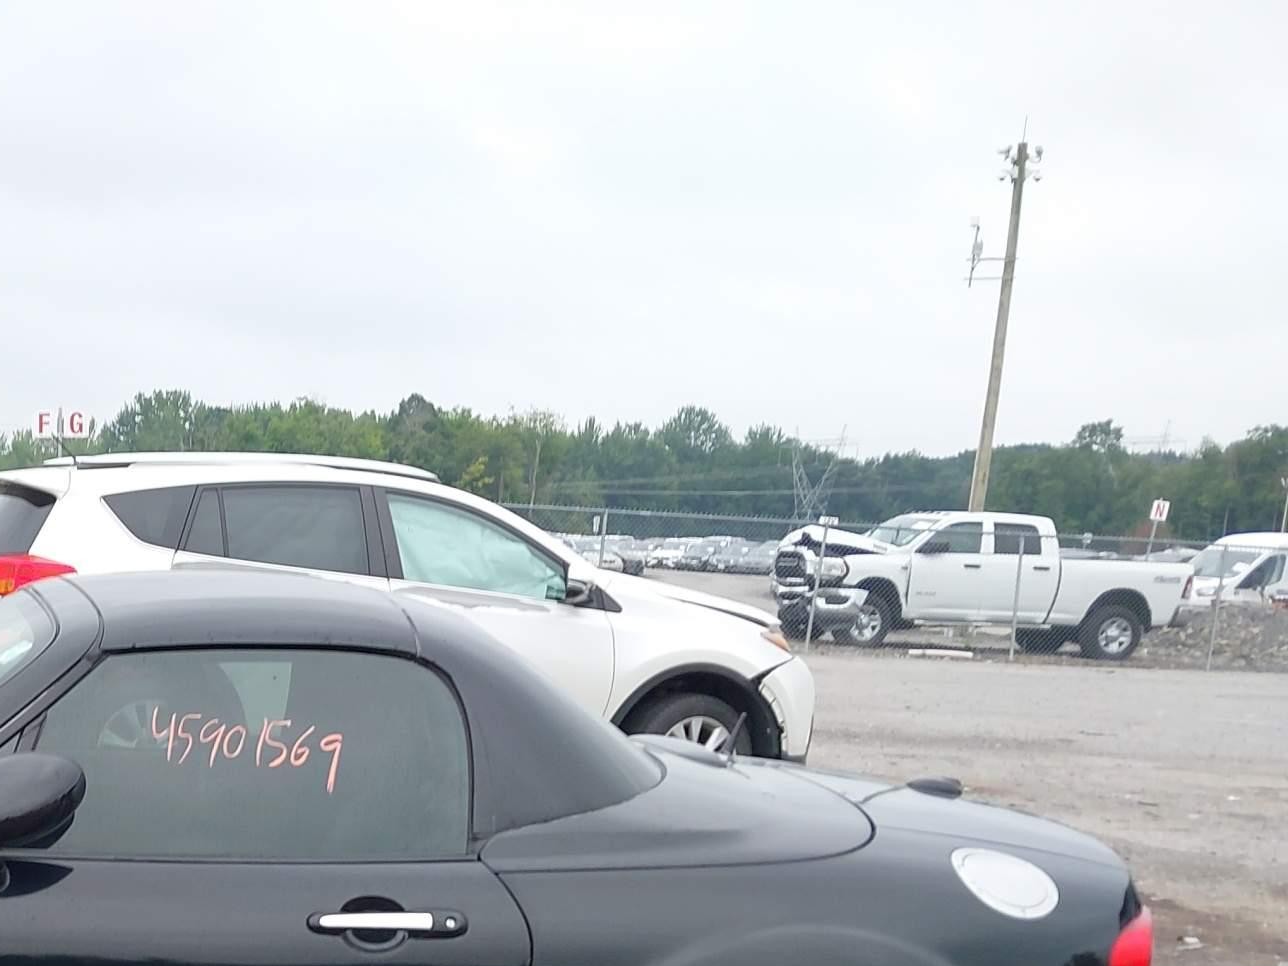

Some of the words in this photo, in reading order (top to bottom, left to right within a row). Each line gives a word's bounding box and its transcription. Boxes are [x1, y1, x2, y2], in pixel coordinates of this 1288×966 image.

[38, 413, 50, 433] F
[70, 412, 83, 433] G
[1154, 503, 1165, 518] N
[151, 705, 343, 794] 45901569
